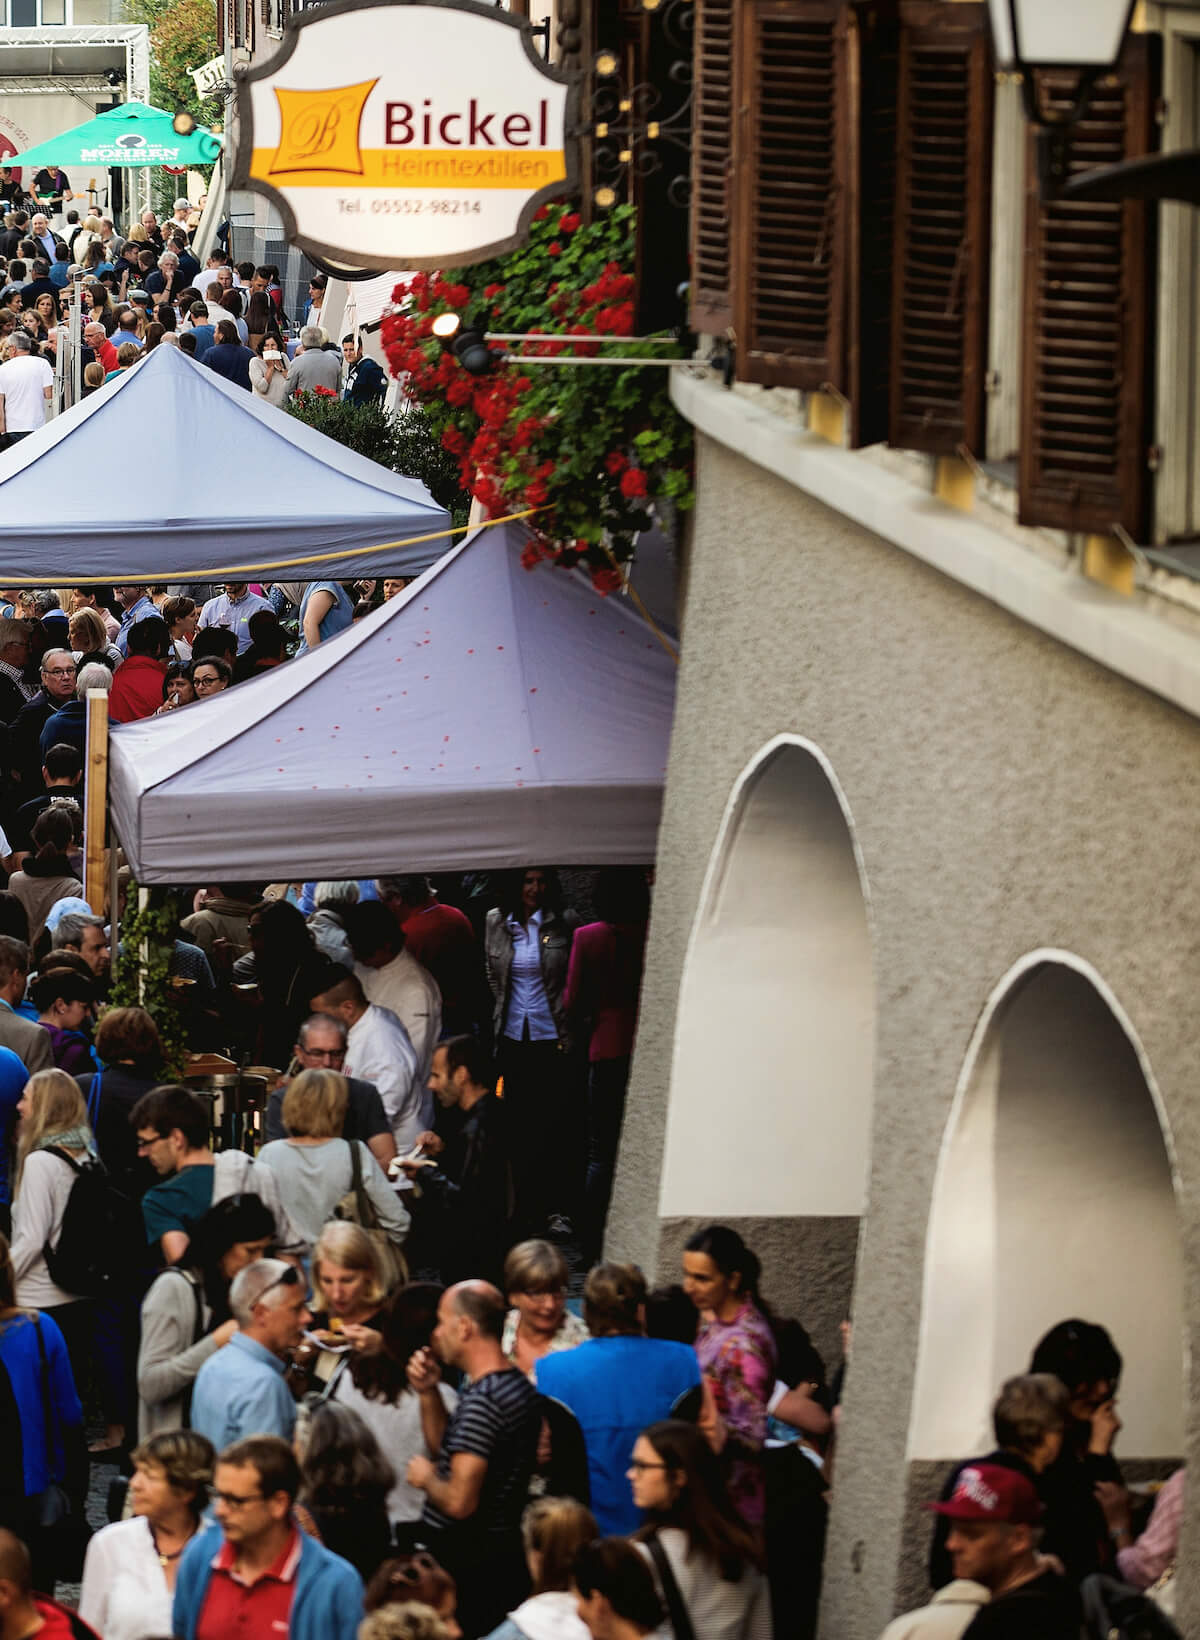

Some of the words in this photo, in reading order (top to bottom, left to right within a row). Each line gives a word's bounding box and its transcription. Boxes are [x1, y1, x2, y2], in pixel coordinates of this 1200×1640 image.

[384, 99, 548, 146] Bickel
[81, 148, 179, 158] MOHREN
[381, 154, 549, 178] Heimtextilien
[337, 200, 364, 214] Tel.
[371, 200, 481, 215] 05552-98214
